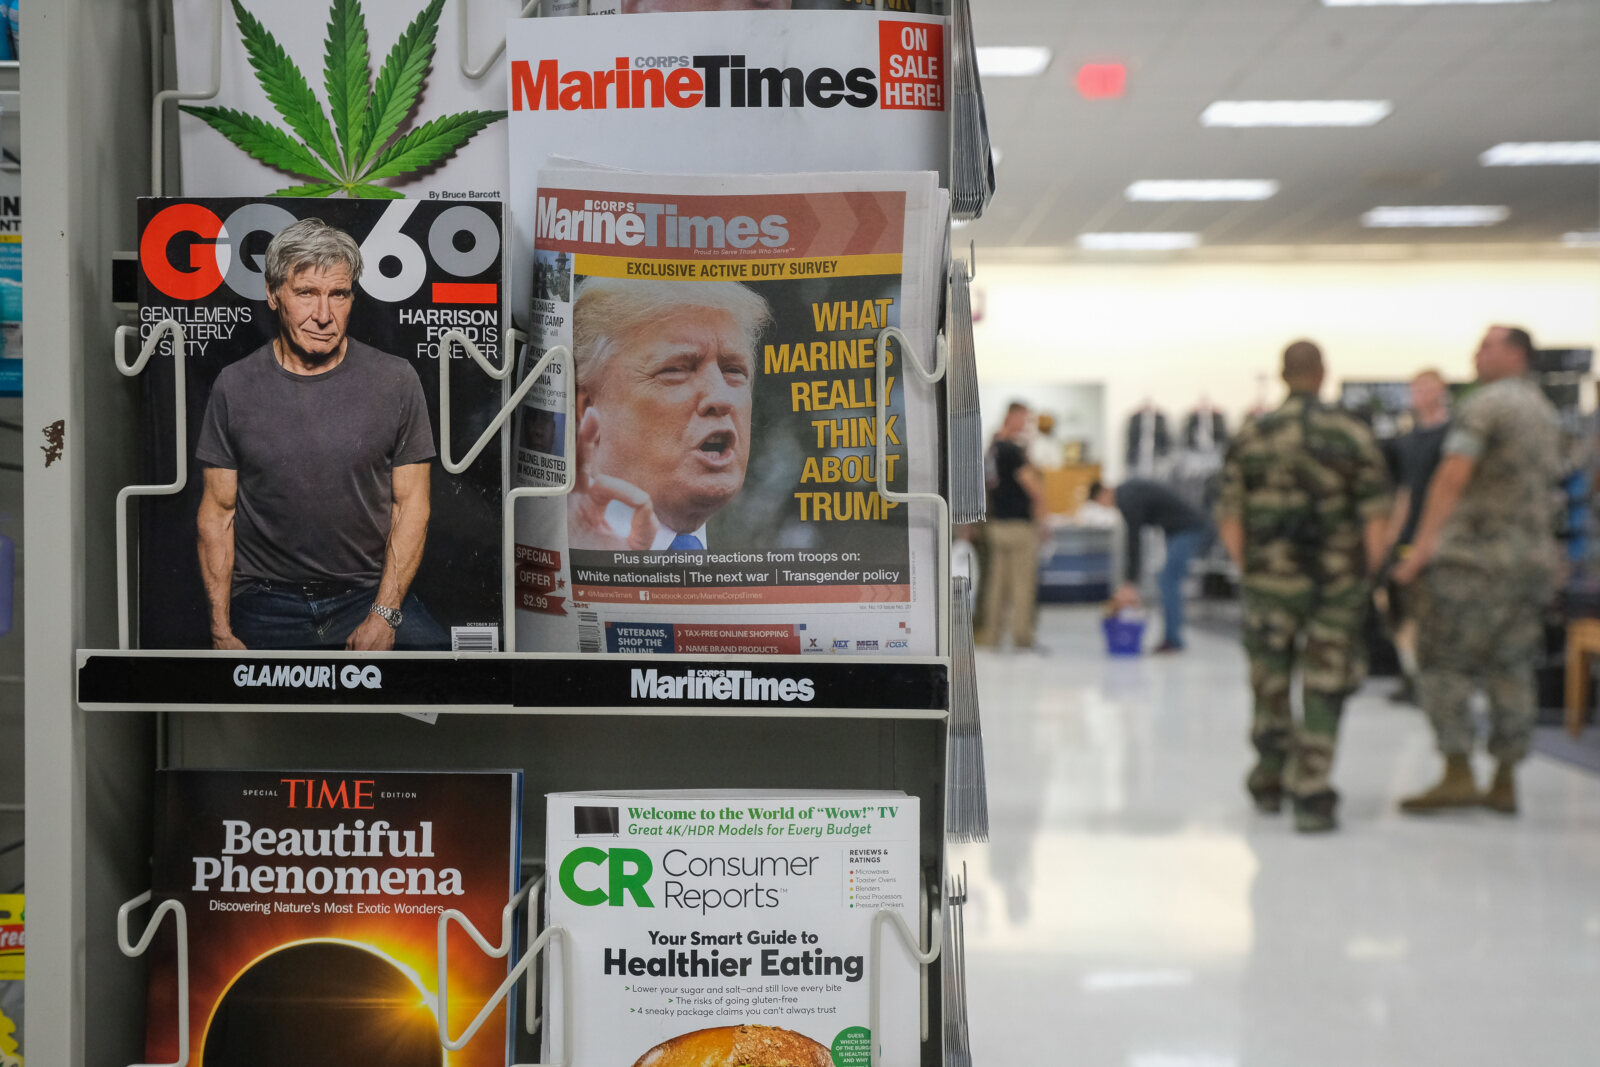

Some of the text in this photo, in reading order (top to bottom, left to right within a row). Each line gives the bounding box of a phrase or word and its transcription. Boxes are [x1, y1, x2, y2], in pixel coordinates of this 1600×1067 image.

[901, 26, 928, 52] ON
[634, 56, 690, 69] CORPS
[889, 53, 938, 80] SALE
[885, 81, 942, 108] HERE!
[429, 190, 501, 200] By Bruce Barcott
[594, 200, 635, 213] CORPS
[140, 203, 299, 302] GQ
[626, 260, 839, 278] EXCLUSIVE ACTIVE DUTY SURVEY
[140, 306, 252, 323] GENTLEMEN'S
[399, 309, 498, 326] HARRISON
[545, 315, 564, 328] CAMP
[811, 298, 893, 332] WHAT
[140, 323, 236, 340] QARTERLY
[482, 327, 498, 343] IS
[160, 340, 209, 357] SITY
[764, 338, 894, 374] MARINES
[811, 415, 900, 448] THINK
[541, 457, 566, 472] BUSTED
[800, 454, 900, 484] ABOUT
[523, 465, 545, 481] HOOKER
[546, 471, 567, 485] STING
[794, 491, 899, 521] TRUMP
[516, 547, 555, 566] SPECIAL
[613, 551, 861, 566] Plus surprising reactions from troops on:
[520, 570, 551, 587] OFFER
[577, 569, 900, 583] White nationalists The next war Transgender policy
[523, 594, 548, 609] $2.99
[616, 628, 668, 638] VETERANS,
[684, 630, 718, 638] TAX-FREE
[720, 630, 748, 638] ONLINE
[618, 638, 663, 647] SHOP THE
[685, 645, 709, 653] NAME
[709, 645, 736, 653] BRAND
[232, 664, 382, 690] GLAMOUR GQ
[242, 778, 417, 810] SPECIAL TIME EDITION
[628, 807, 697, 820] Welcome
[700, 808, 716, 820] to
[719, 807, 744, 820] the
[747, 807, 794, 820] World
[798, 806, 815, 820] of
[877, 806, 899, 819] TV
[221, 820, 435, 857] Beautiful
[628, 823, 872, 838] Great 4K/HDR Models for Every Budget
[662, 848, 819, 878] Consumer
[192, 855, 465, 896] Phenomena
[558, 846, 655, 909] CR
[209, 899, 444, 915] Discovering Nature's Most Exotic Wonders
[648, 930, 819, 946] Your Smart Guide to
[604, 947, 864, 983] Healthier Eating
[632, 984, 658, 993] Lower
[659, 986, 678, 995] your
[680, 987, 704, 995] sugar
[706, 986, 723, 994] and
[765, 984, 779, 993] still
[781, 984, 798, 992] love
[800, 986, 824, 995] every
[826, 983, 842, 992] bite
[676, 995, 798, 1006] The risks of going gluten-free
[645, 1008, 675, 1017] sneaky
[676, 1008, 714, 1017] package
[716, 1007, 743, 1016] claims
[745, 1008, 761, 1017] you
[763, 1006, 784, 1015] can't
[786, 1006, 815, 1015] always
[817, 1006, 837, 1014] trust
